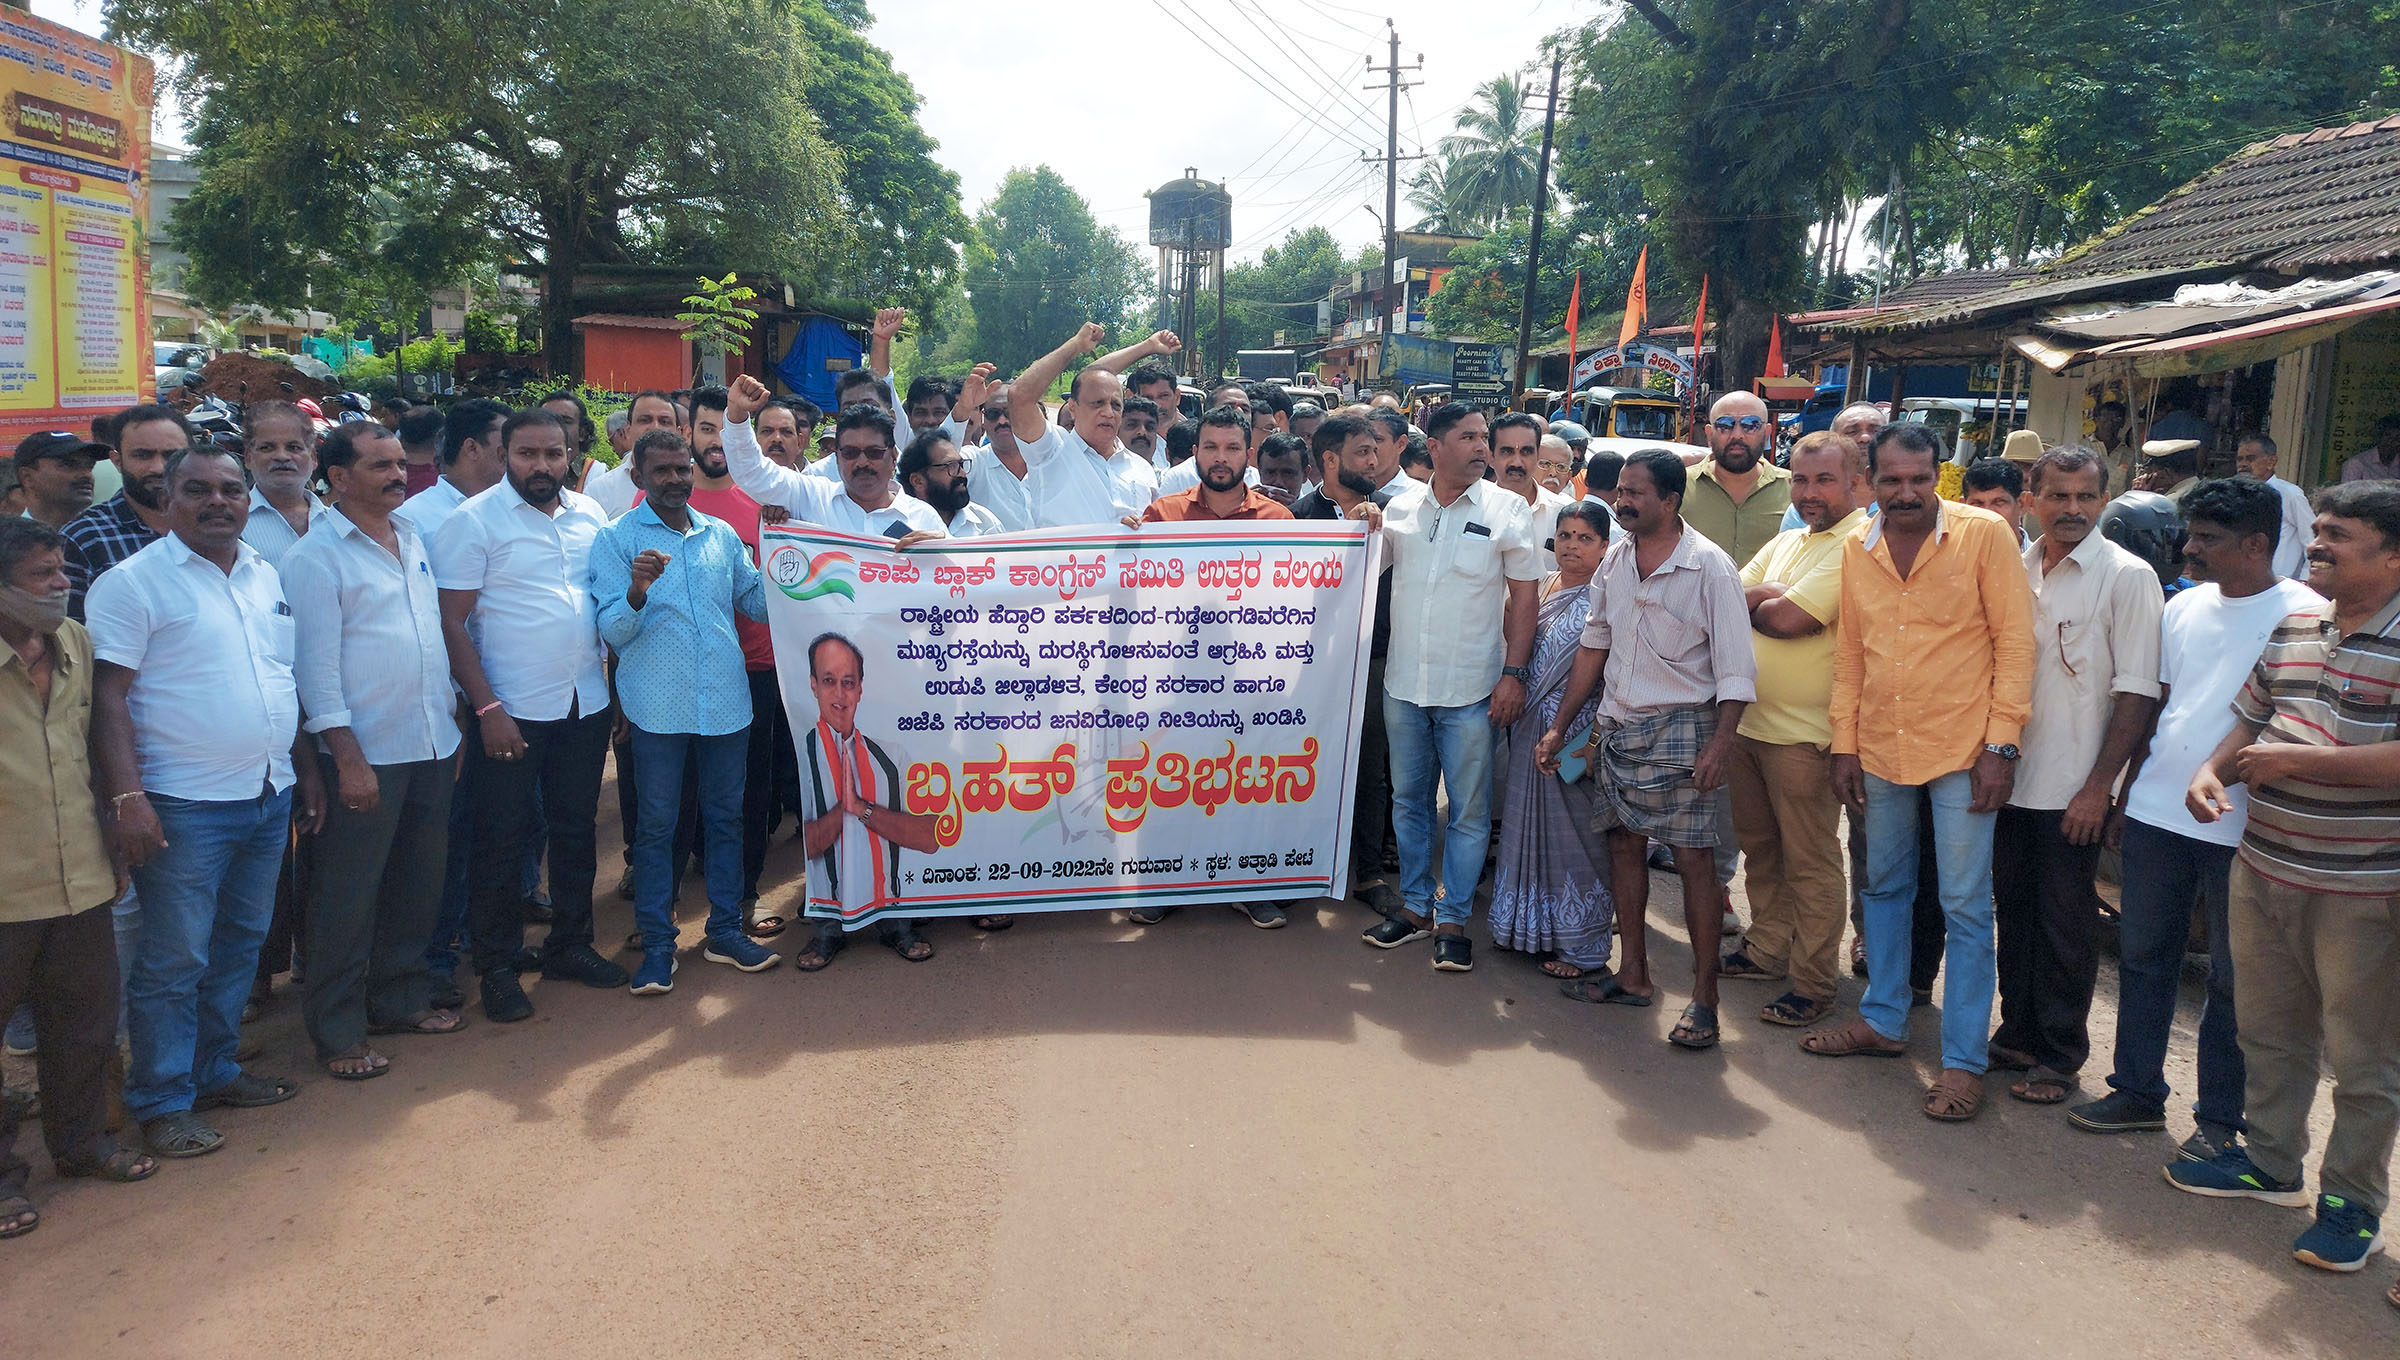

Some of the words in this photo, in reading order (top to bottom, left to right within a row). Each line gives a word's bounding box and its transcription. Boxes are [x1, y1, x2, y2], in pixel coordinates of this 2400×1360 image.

[20, 101, 63, 141] ನವರಾತ್ರಿ
[67, 114, 117, 152] ಮಹೋತ್ಸವ
[1455, 345, 1492, 358] Poornima
[858, 558, 921, 584] ಕಾಪು
[933, 556, 996, 598] ಬ್ಲಾಕ್
[1008, 553, 1106, 601] ಕಾಂಗ್ರೆಸ್
[1119, 553, 1185, 589] ಸಮಿತಿ
[1197, 551, 1262, 601] ಉತ್ತರ
[1272, 551, 1343, 589] ವಲಯ
[901, 604, 979, 636] ರಾಷ್ಟ್ರೀಯ
[989, 604, 1045, 633] ಹೆದ್ದಾರಿ
[897, 639, 1030, 672] ಮುಖ್ಯರಸ್ತೆಯನ್ನು
[1039, 639, 1199, 671] ದುರಸ್ಥಿಗೊಳಿಸುವಂತೆ
[1208, 641, 1266, 665] ಆಗ್ರಹಿಸಿ
[1276, 640, 1314, 664] ಮತ್ತು
[925, 676, 985, 695] ಉಡುಪಿ
[995, 675, 1085, 701] ಜಿಲ್ಲಾಡಳಿತ,
[1095, 674, 1147, 699] ಕೇಂದ್ರ
[1156, 675, 1225, 693] ಸರಕಾರ
[1233, 675, 1285, 693] ಹಾಗೂ
[898, 711, 944, 731] ಬಿಜೆಪಿ
[954, 710, 1041, 730] ಸರಕಾರದ
[1050, 709, 1149, 731] ಜನವಿರೋಧಿ
[1158, 709, 1244, 735] ನೀತಿಯನ್ನು
[1252, 708, 1306, 725] ಖಂಡಿಸಿ
[904, 743, 1077, 850] ಬೃಹತ್
[1105, 736, 1320, 834] ಪ್ರತಿಭಟನೆ
[923, 863, 981, 884] ದಿನಾಂಕ:
[989, 858, 1114, 880] 22-09-2022ನೇ
[1122, 855, 1183, 874] ಗುರುವಾರ
[1202, 852, 1232, 883] ಸ್ಥಳ:
[1239, 853, 1277, 873] ಆತ್ರಾಡಿ
[1285, 848, 1313, 866] ಪೇಟೆ
